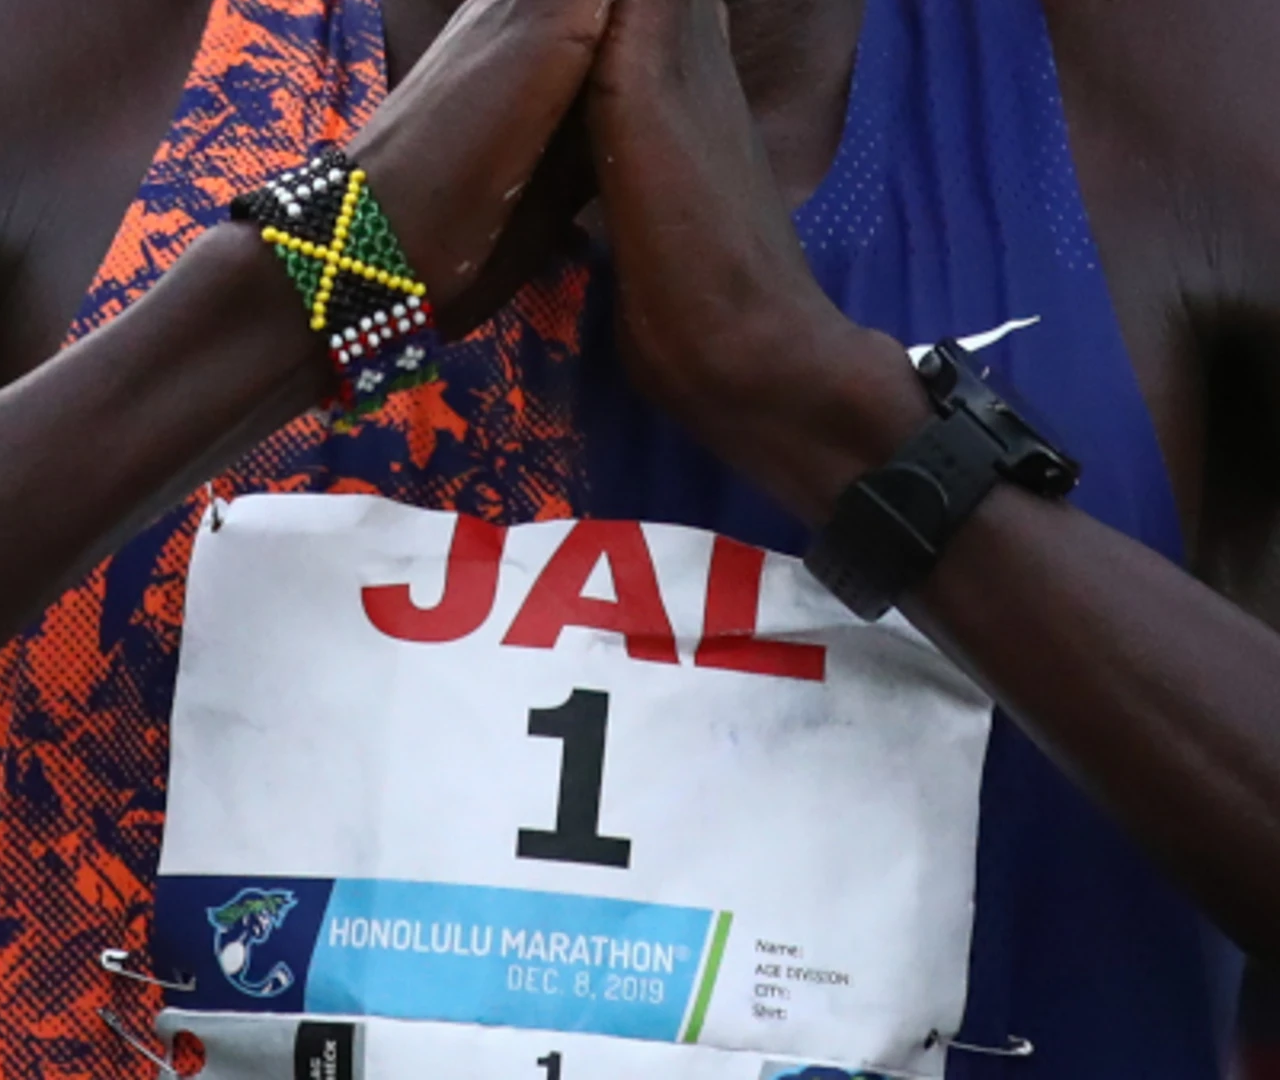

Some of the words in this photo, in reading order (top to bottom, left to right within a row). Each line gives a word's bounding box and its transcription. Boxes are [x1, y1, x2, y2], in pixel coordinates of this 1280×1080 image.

[361, 512, 827, 683] JAL
[515, 687, 632, 870] 1
[328, 916, 494, 957] HONOLULU
[507, 963, 565, 996] DEC.
[573, 970, 597, 1001] 8,
[603, 973, 665, 1005] 2019
